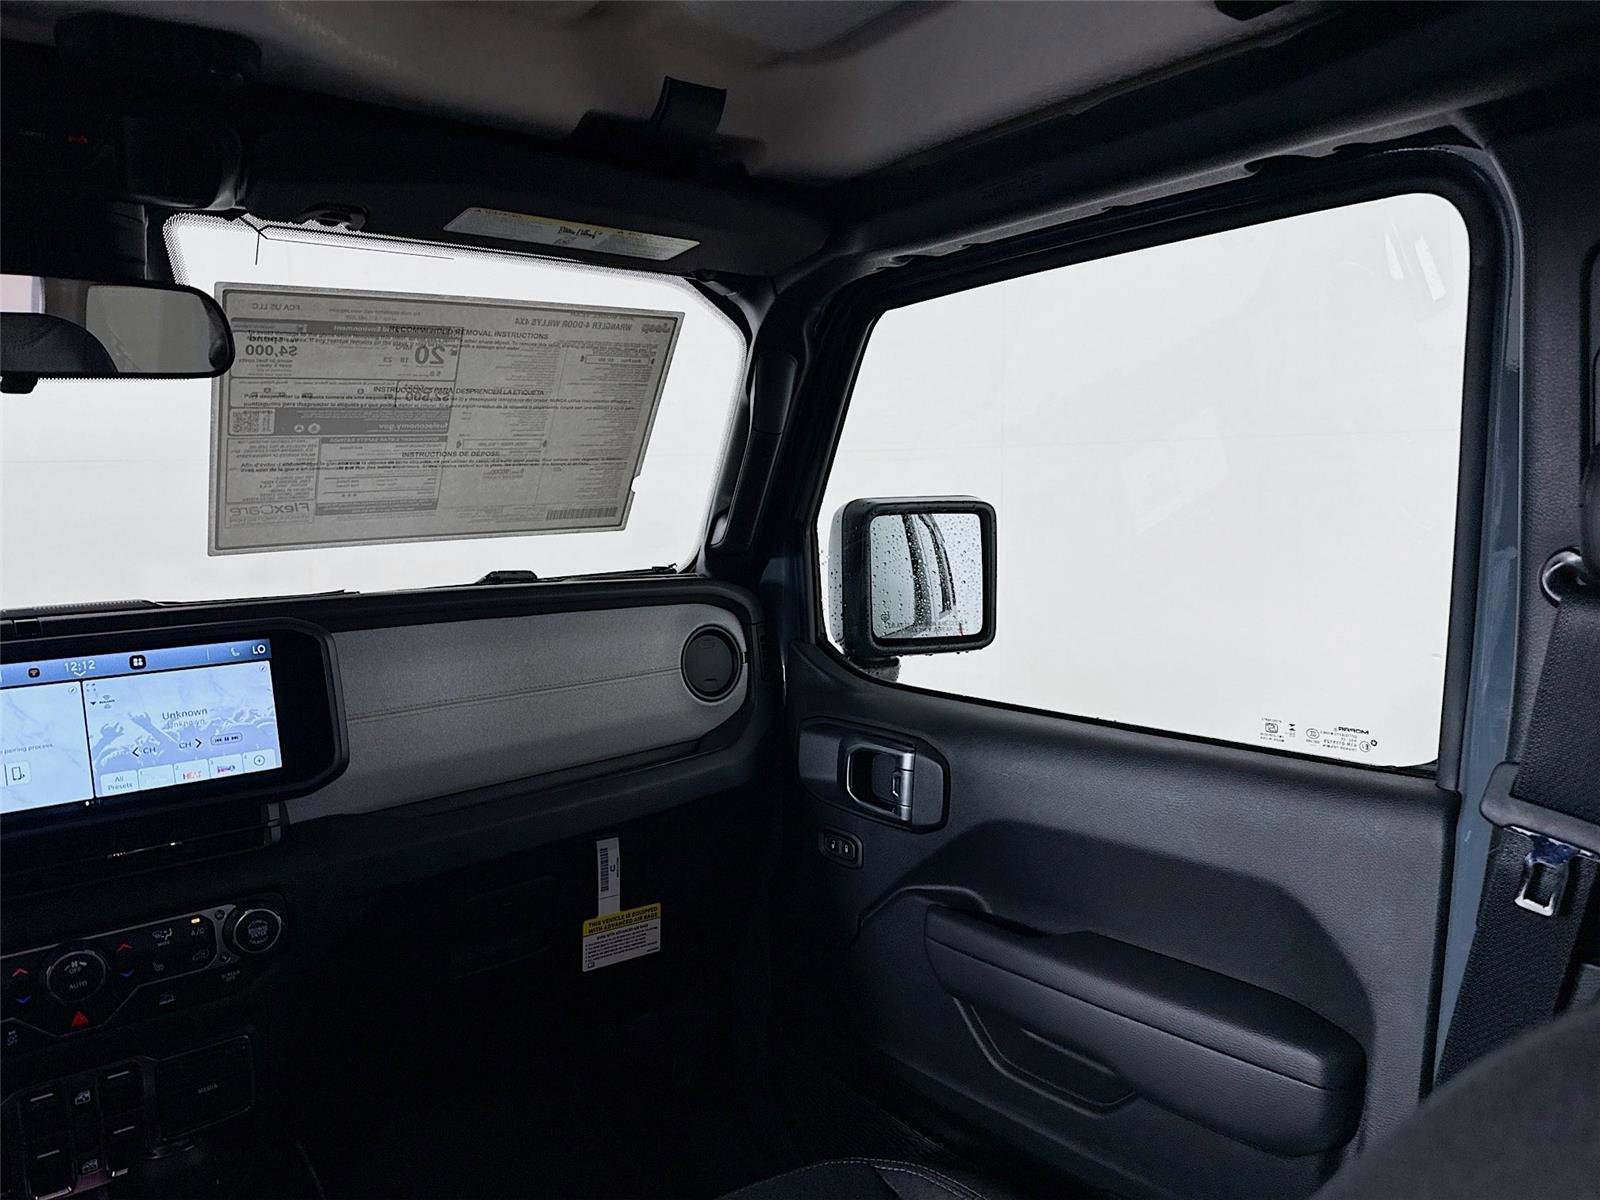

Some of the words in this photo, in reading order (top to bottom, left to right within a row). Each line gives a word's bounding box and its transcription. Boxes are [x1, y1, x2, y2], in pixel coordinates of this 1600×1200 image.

[454, 328, 493, 338] REMOVAL
[493, 331, 549, 340] INSTRUCTIONS
[455, 387, 502, 396] DESPRENDER
[502, 388, 512, 396] LA
[402, 450, 457, 458] INSTRUCTIONS
[458, 450, 470, 458] DE
[252, 643, 266, 656] LO
[64, 659, 96, 673] 12:12
[162, 707, 208, 721] Unknown
[143, 746, 156, 755] CH
[179, 741, 192, 750] CH
[114, 775, 124, 783] All
[107, 782, 133, 792] Presets
[589, 920, 601, 928] THIS
[601, 914, 624, 925] VEHICLE
[632, 906, 657, 917] EQUIPPED
[68, 979, 88, 991] AUTO
